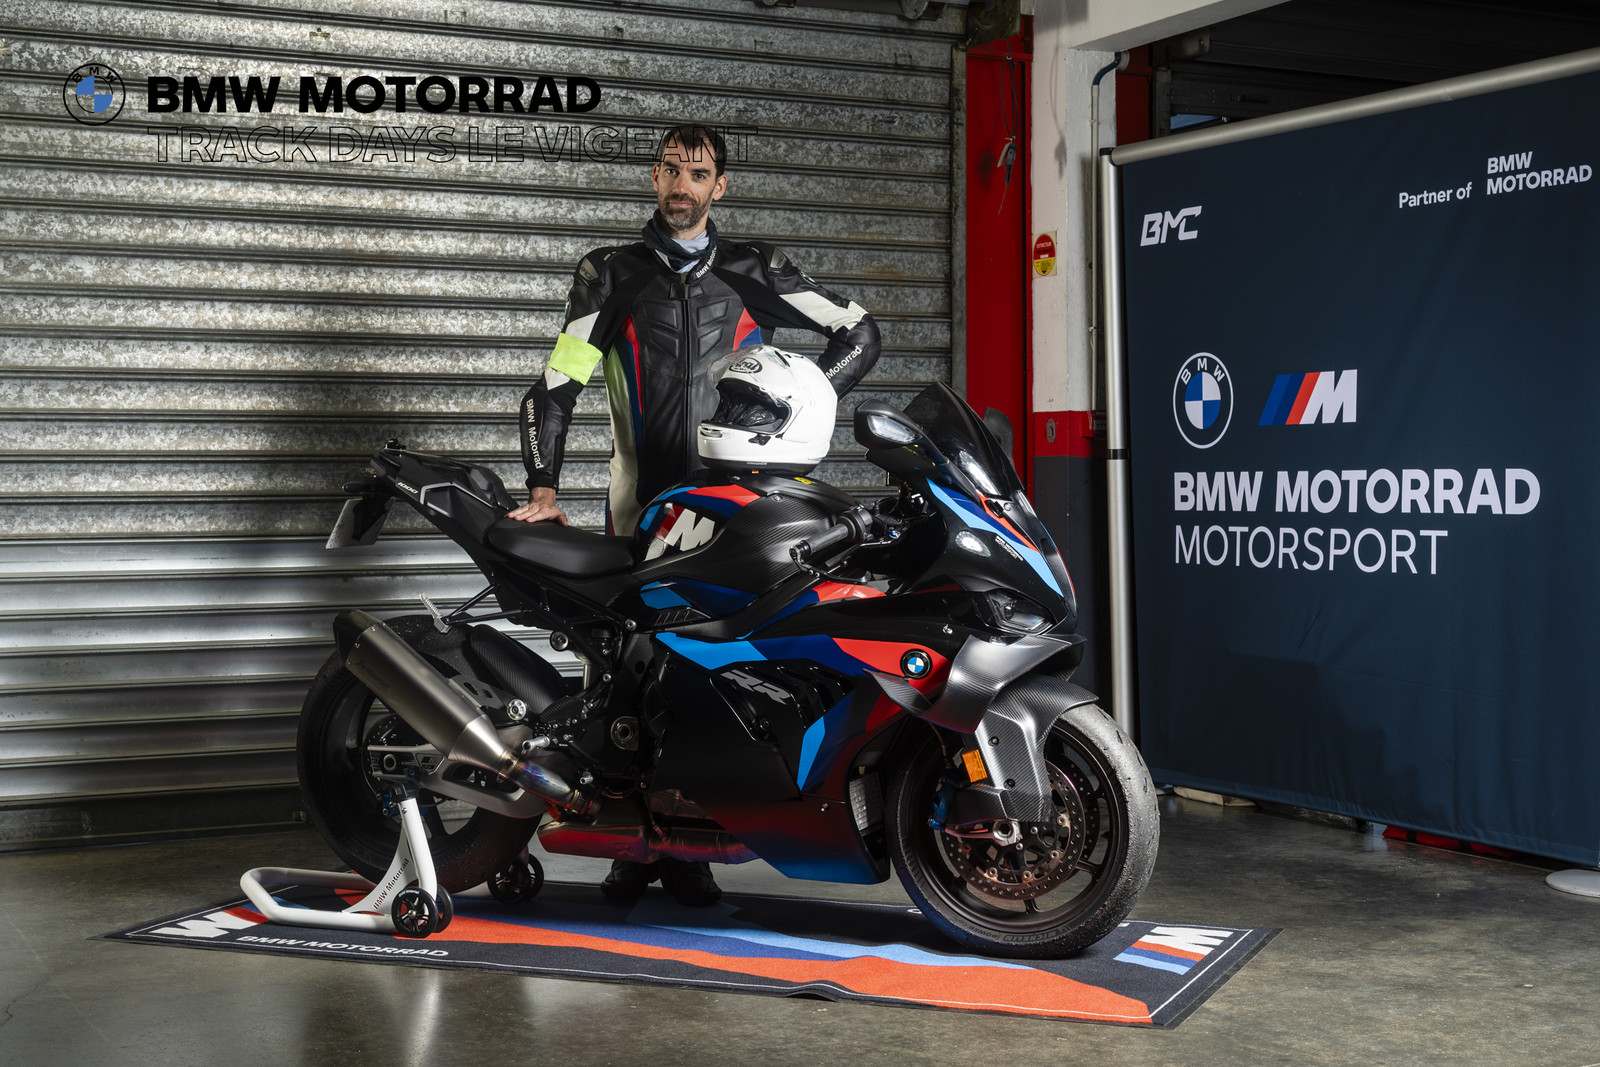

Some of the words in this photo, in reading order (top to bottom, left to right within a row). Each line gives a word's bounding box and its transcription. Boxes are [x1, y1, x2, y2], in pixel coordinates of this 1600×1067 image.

[1486, 164, 1593, 196] MOTORRAD
[1487, 151, 1533, 175] BMW
[1398, 187, 1453, 209] Partner
[1456, 182, 1473, 201] of
[1140, 206, 1203, 247] BMC
[825, 345, 863, 380] Motorrad
[1180, 357, 1226, 385] BMW
[526, 398, 536, 423] BMW
[1299, 368, 1358, 425] M
[528, 426, 545, 470] Motorrad
[1173, 471, 1264, 512] BMW
[1275, 468, 1541, 515] MOTORRAD
[1174, 524, 1449, 575] MOTORSPORT
[373, 890, 388, 910] BMW
[385, 857, 410, 892] Motorrad
[236, 935, 306, 946] BMW
[302, 941, 450, 957] MOTORRAD
